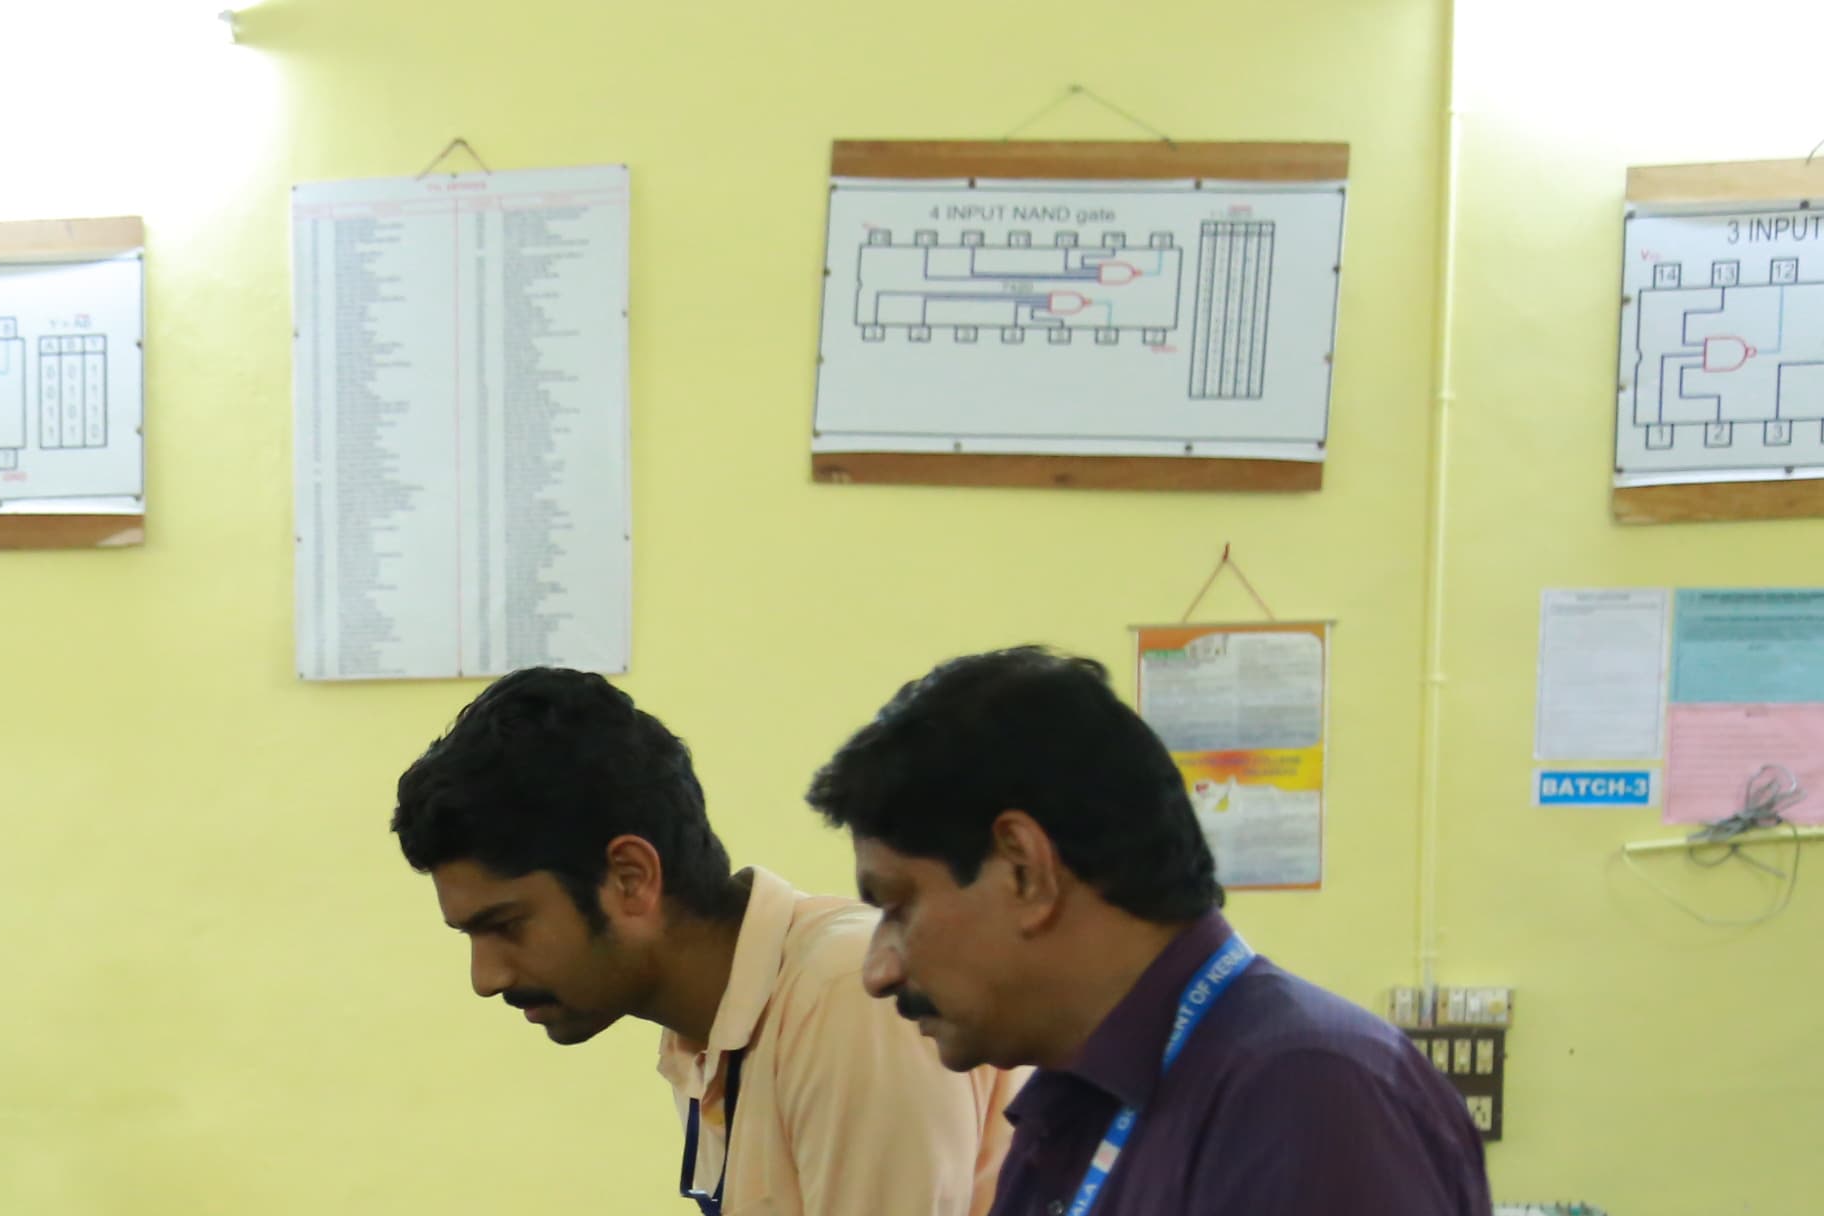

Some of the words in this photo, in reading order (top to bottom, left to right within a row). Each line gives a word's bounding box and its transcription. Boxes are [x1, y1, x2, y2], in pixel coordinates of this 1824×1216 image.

[929, 206, 940, 221] 4
[947, 206, 1006, 222] INPUT
[1013, 206, 1071, 222] NAND
[1076, 207, 1116, 225] gate
[1727, 220, 1740, 244] 3
[1749, 215, 1824, 243] INPUT
[1658, 267, 1677, 282] 14
[1716, 265, 1735, 281] 13
[1776, 263, 1794, 280] 12
[1714, 425, 1725, 442] 2
[1773, 424, 1784, 441] 3
[1542, 777, 1648, 797] BATCH-3
